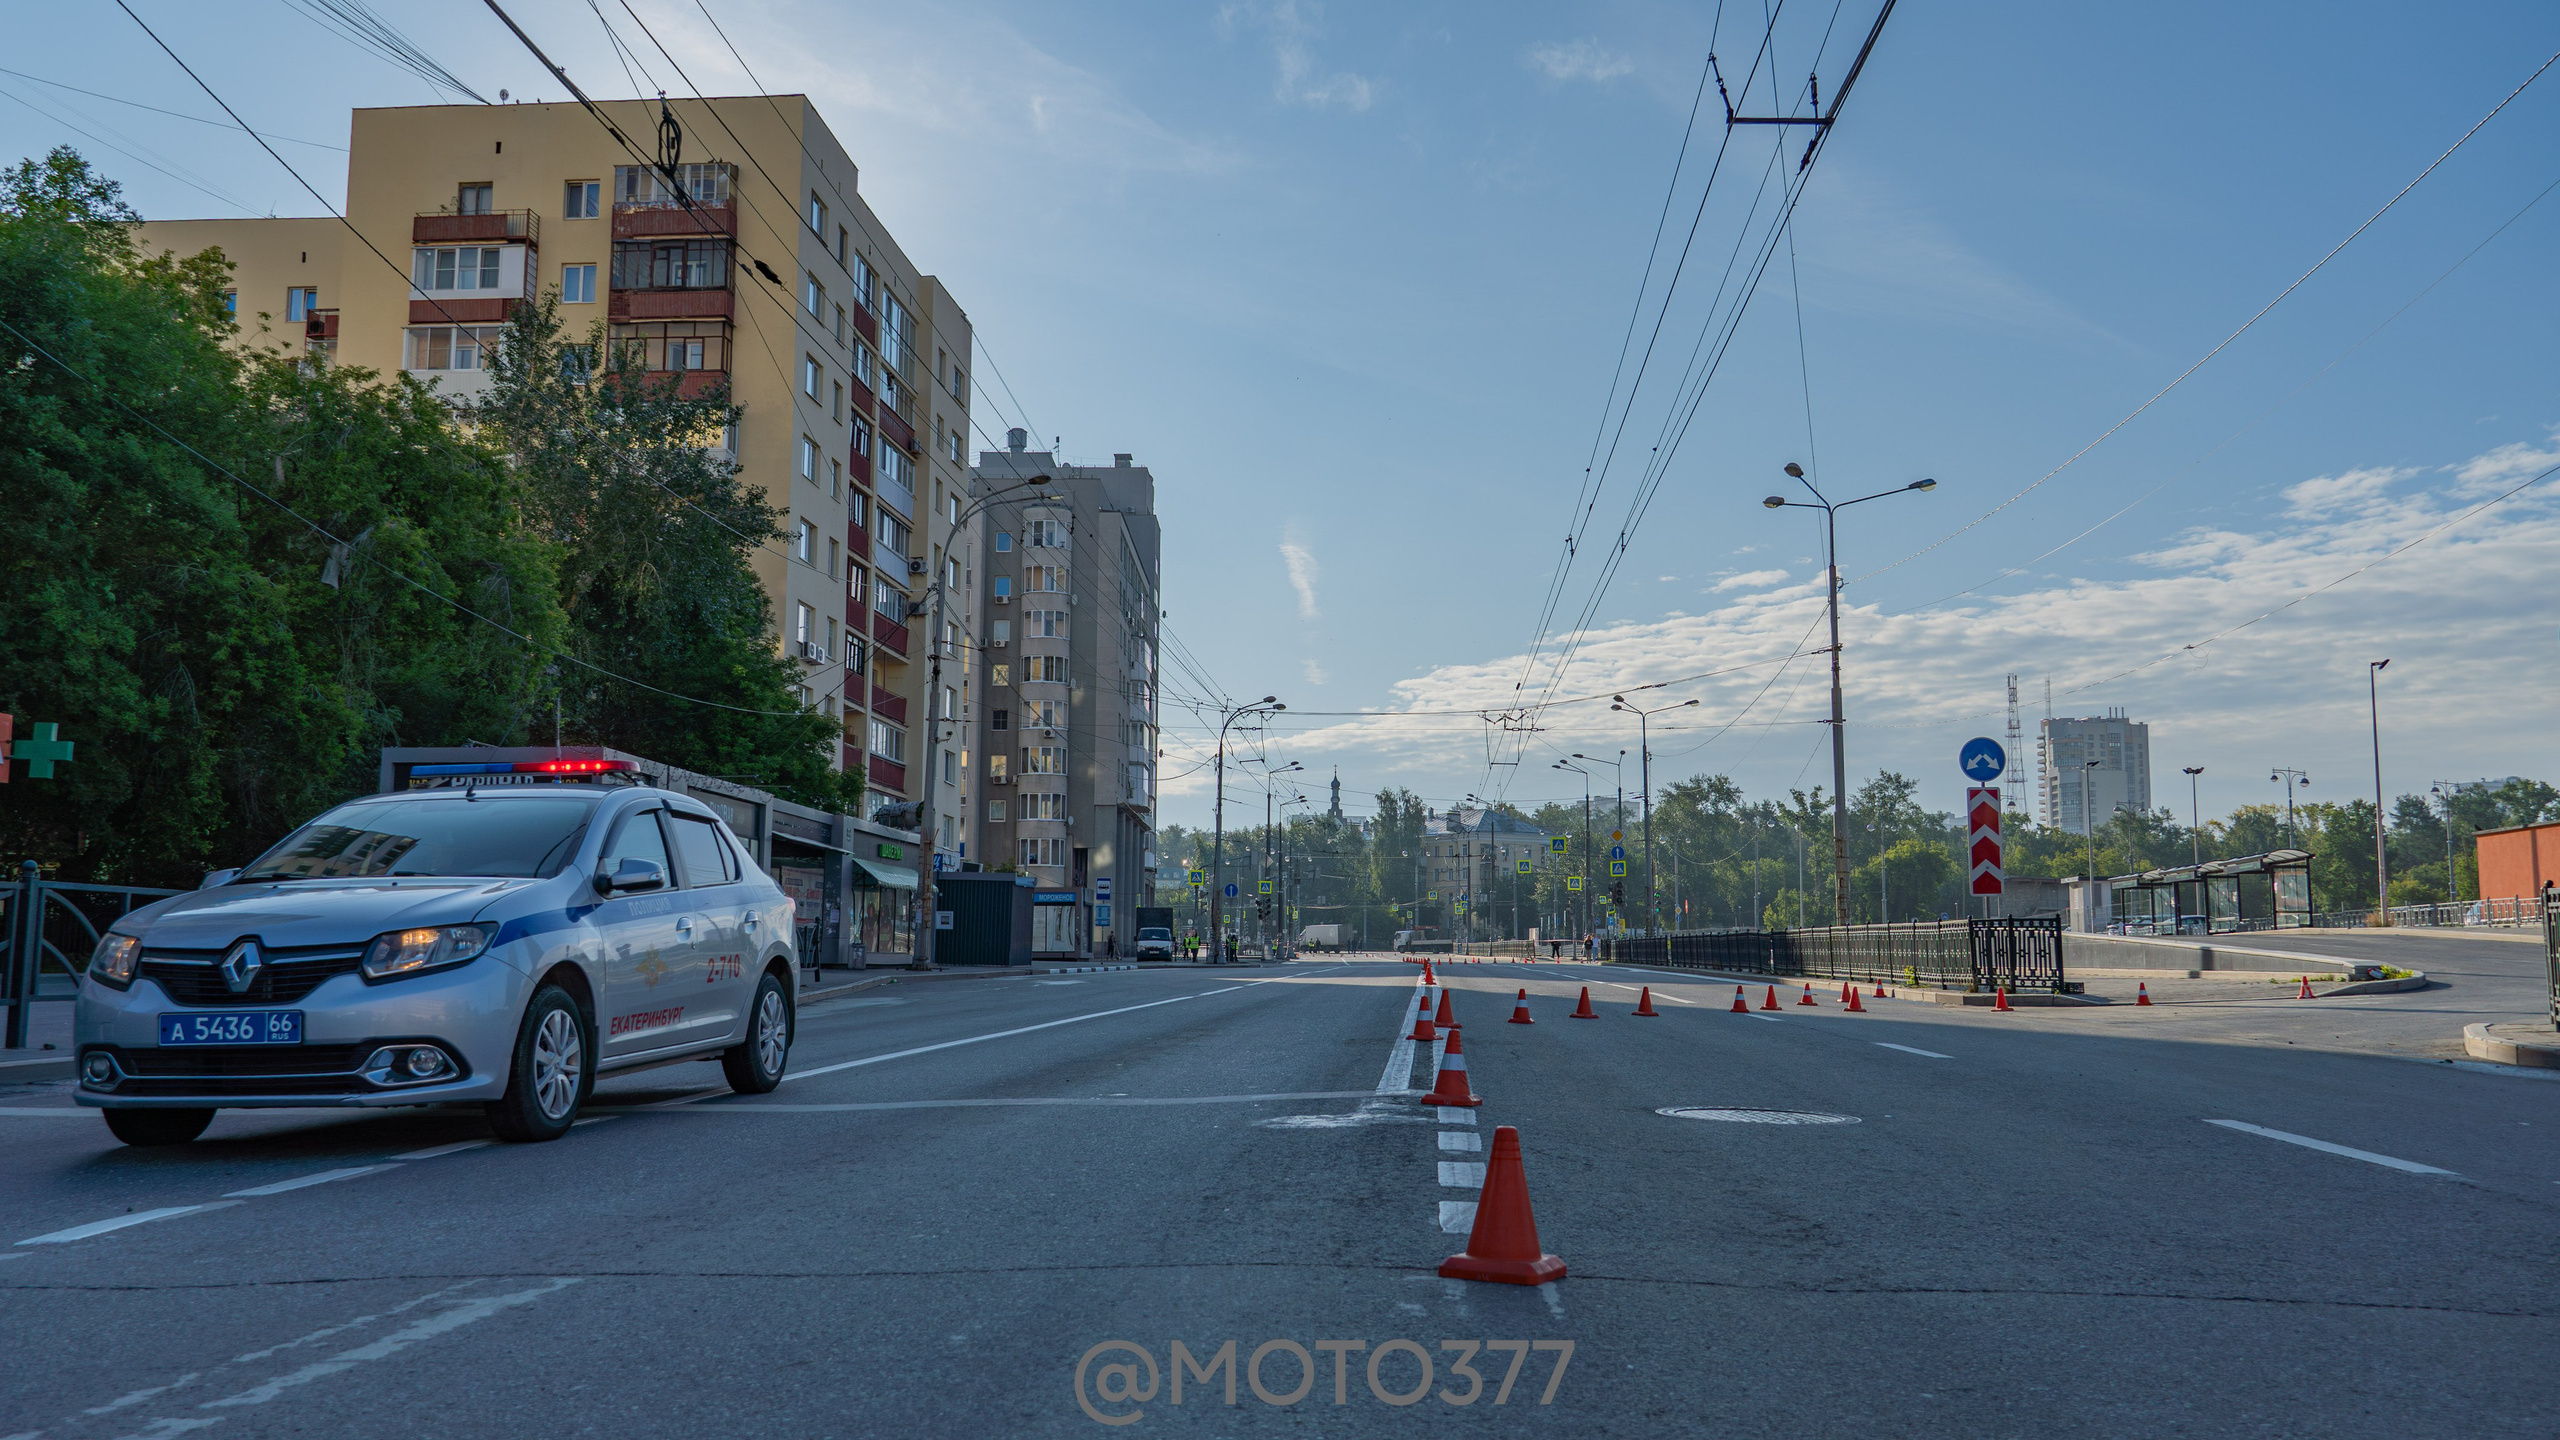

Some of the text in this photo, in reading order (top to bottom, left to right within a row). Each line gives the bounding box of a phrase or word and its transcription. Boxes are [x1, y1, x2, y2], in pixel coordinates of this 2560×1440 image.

[627, 897, 673, 916] ПОЛИЦИЯ
[706, 953, 741, 983] 2-710
[195, 1016, 254, 1040] 5436
[269, 1014, 292, 1032] 66
[610, 1006, 685, 1035] ЕКАТЕРИНБУРГ
